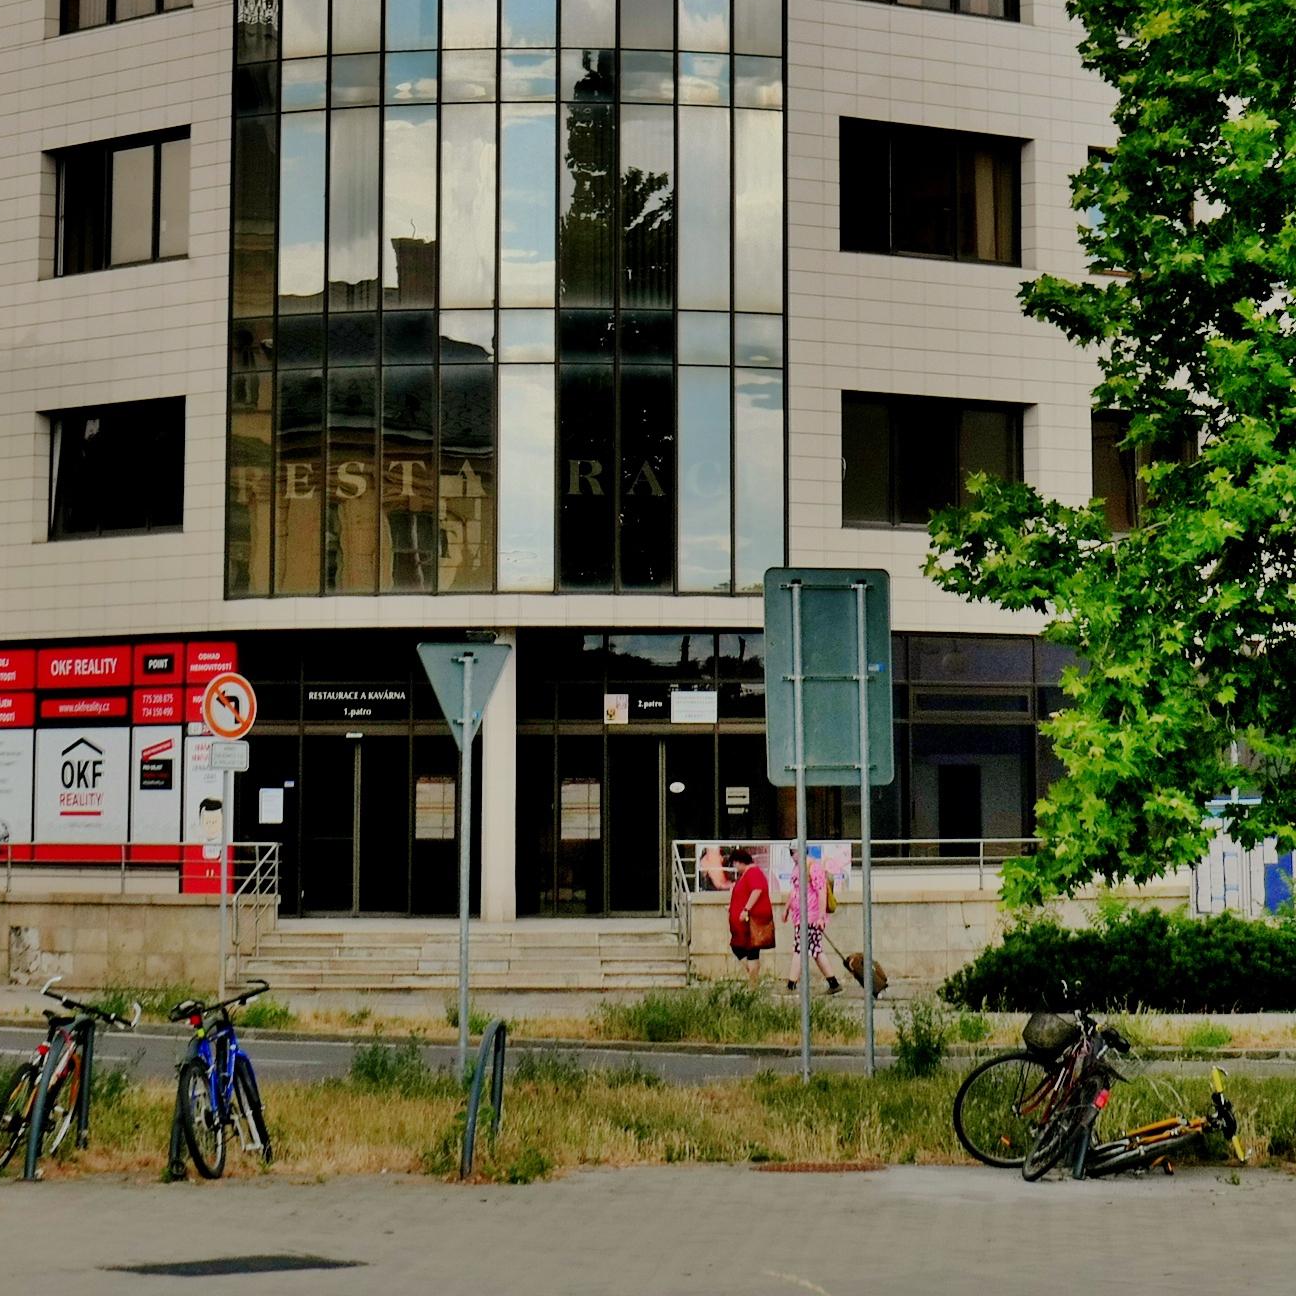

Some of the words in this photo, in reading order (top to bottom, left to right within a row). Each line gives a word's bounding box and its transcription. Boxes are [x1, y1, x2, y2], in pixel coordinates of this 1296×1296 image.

[51, 659, 72, 676] OKF
[74, 658, 118, 675] REALITY
[148, 658, 169, 670] POINT
[308, 691, 358, 700] RESTAURACE
[360, 691, 367, 700] A
[368, 689, 406, 700] KAVÁRNA
[58, 700, 111, 715] www.okfreality.cz
[637, 699, 663, 709] 2.patro
[343, 707, 372, 718] 1.patro
[61, 760, 103, 789] OKF
[59, 793, 103, 807] REALITY
